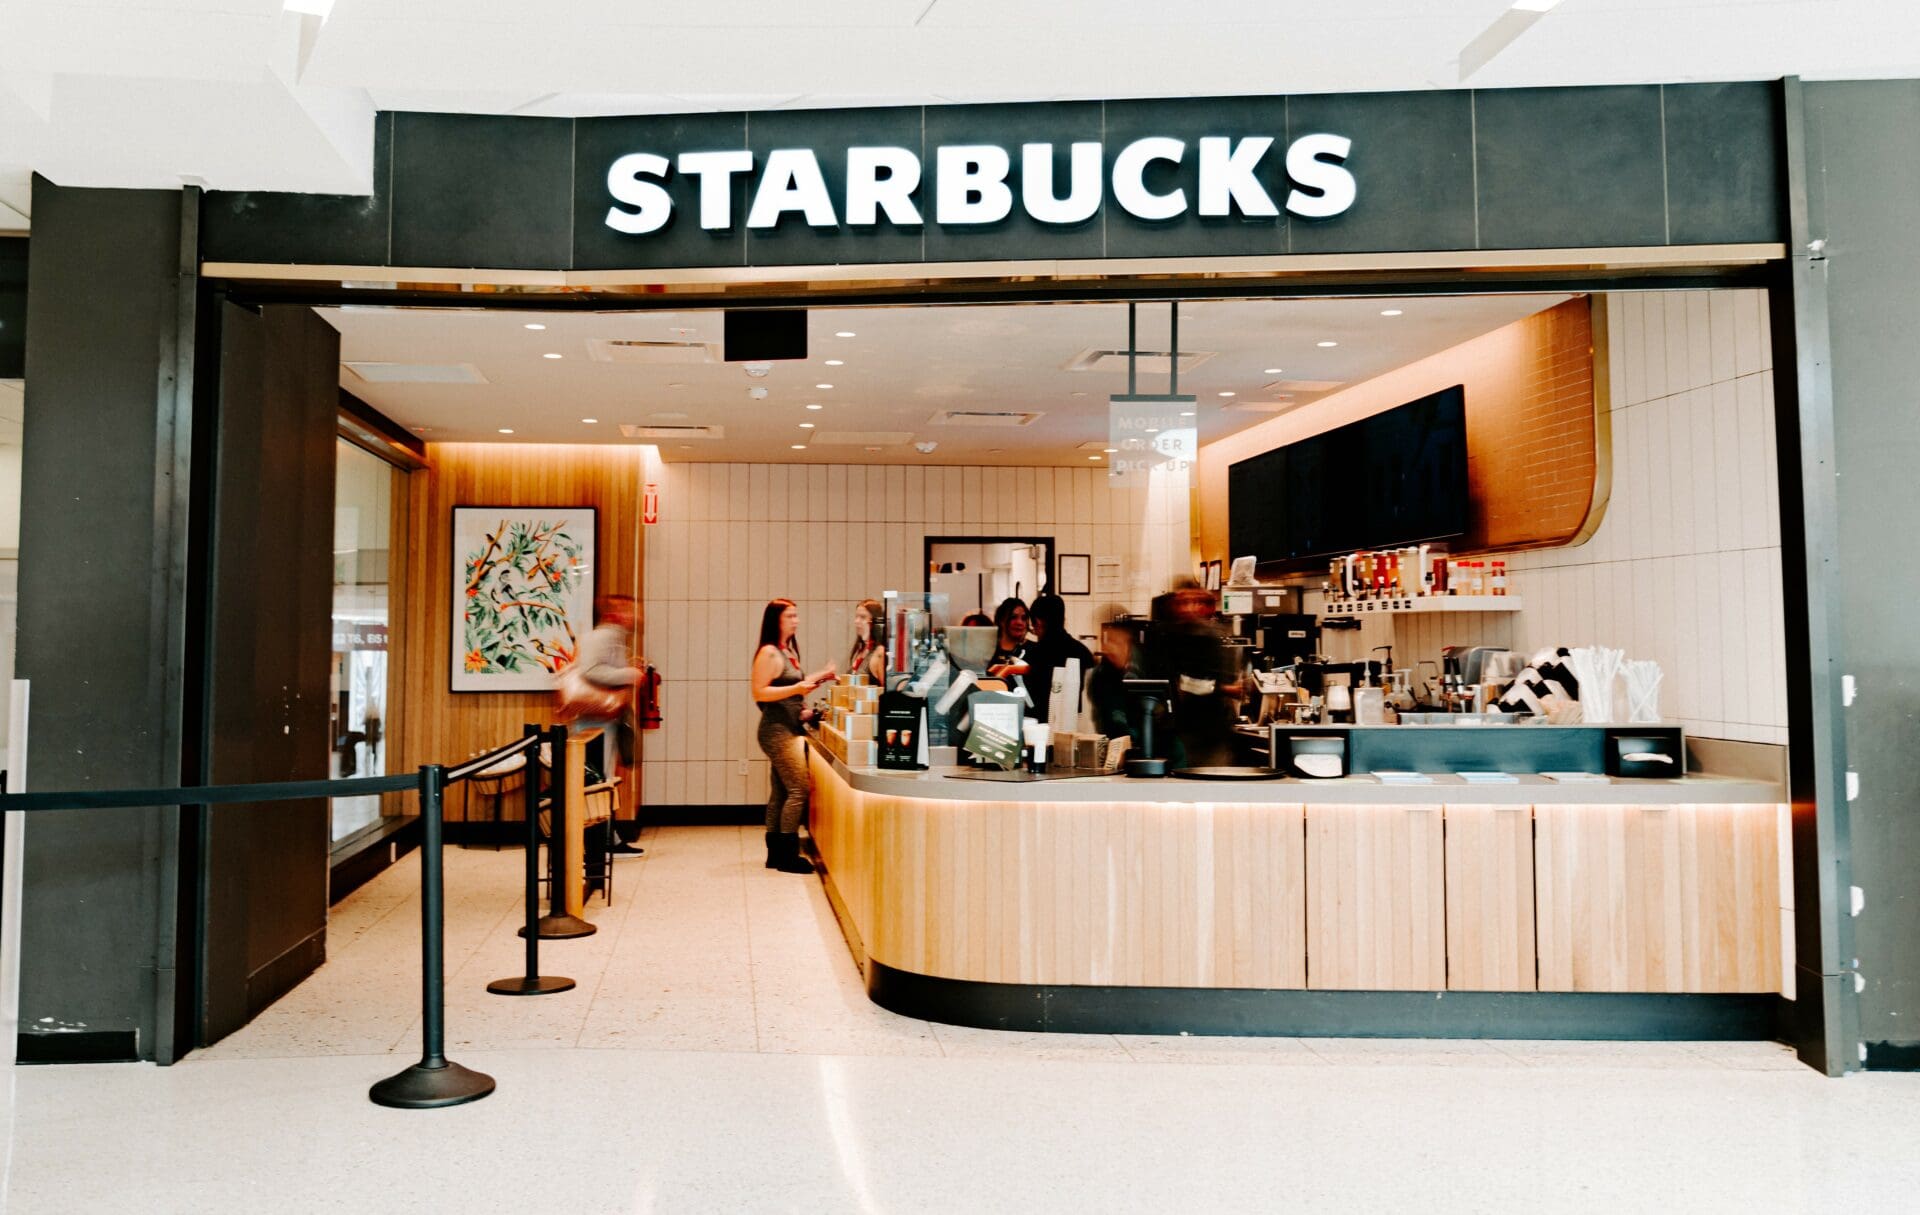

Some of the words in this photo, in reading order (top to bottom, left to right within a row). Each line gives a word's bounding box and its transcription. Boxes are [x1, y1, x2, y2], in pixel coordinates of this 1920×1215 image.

[604, 133, 1357, 235] STARBUCKS
[1121, 438, 1182, 451] ORDER
[1166, 460, 1188, 472] UP
